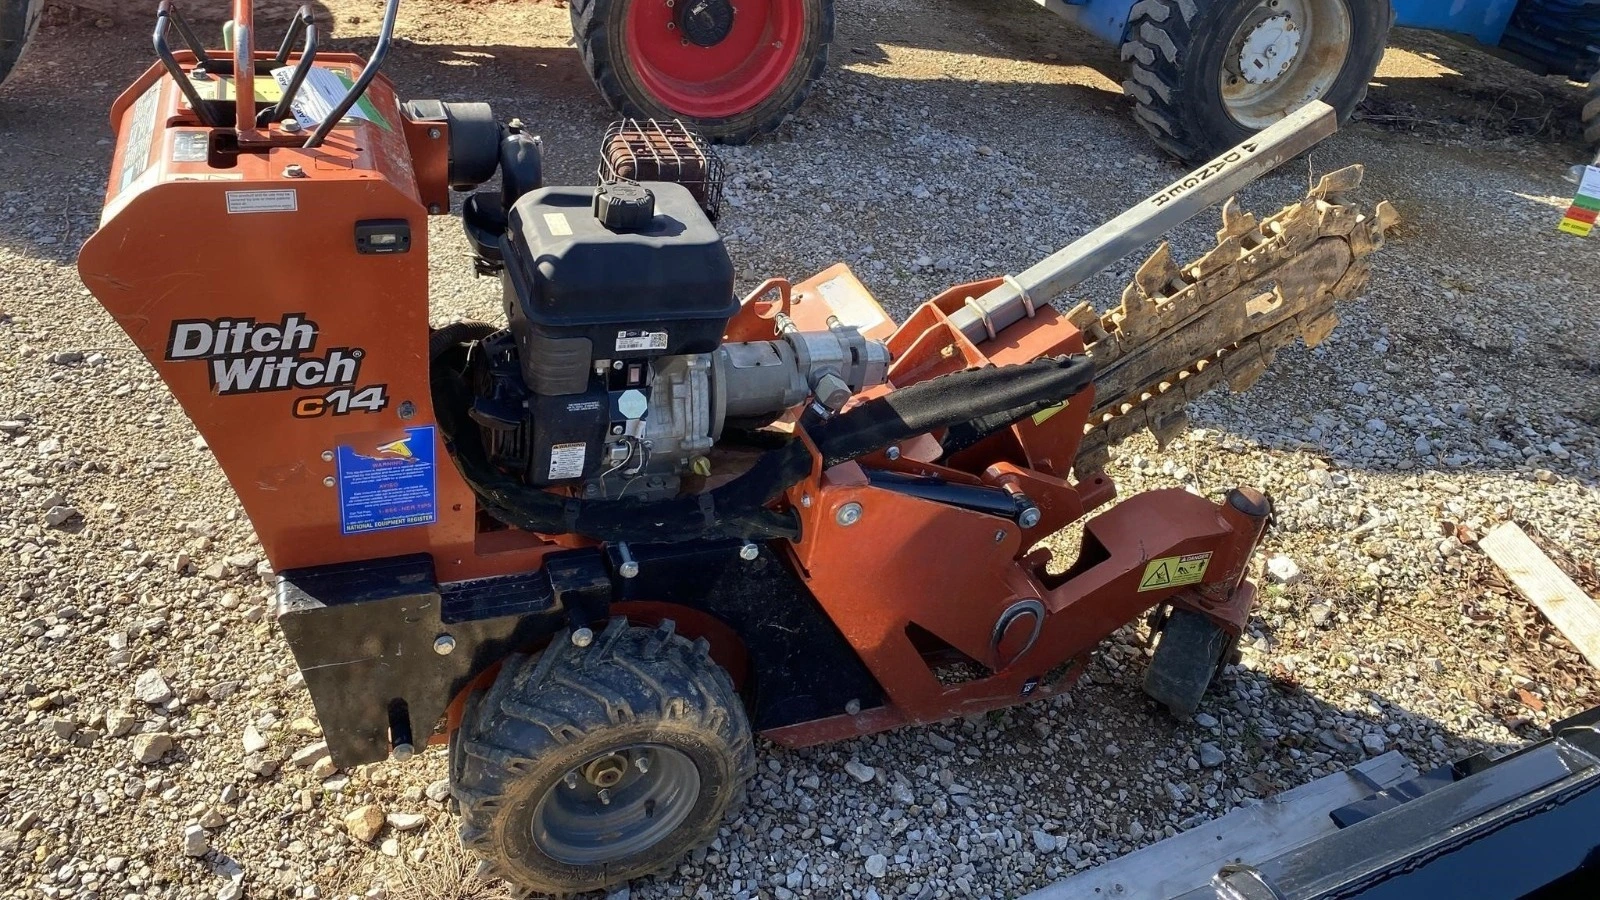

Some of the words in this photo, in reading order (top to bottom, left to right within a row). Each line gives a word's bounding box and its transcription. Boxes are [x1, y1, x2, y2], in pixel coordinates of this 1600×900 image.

[1152, 151, 1242, 207] DANGER
[170, 316, 316, 358] Ditch
[346, 522, 373, 531] NATIONAL
[374, 518, 406, 527] EQUIPMENT
[406, 515, 433, 523] REGISTER
[1186, 553, 1210, 562] DANGER
